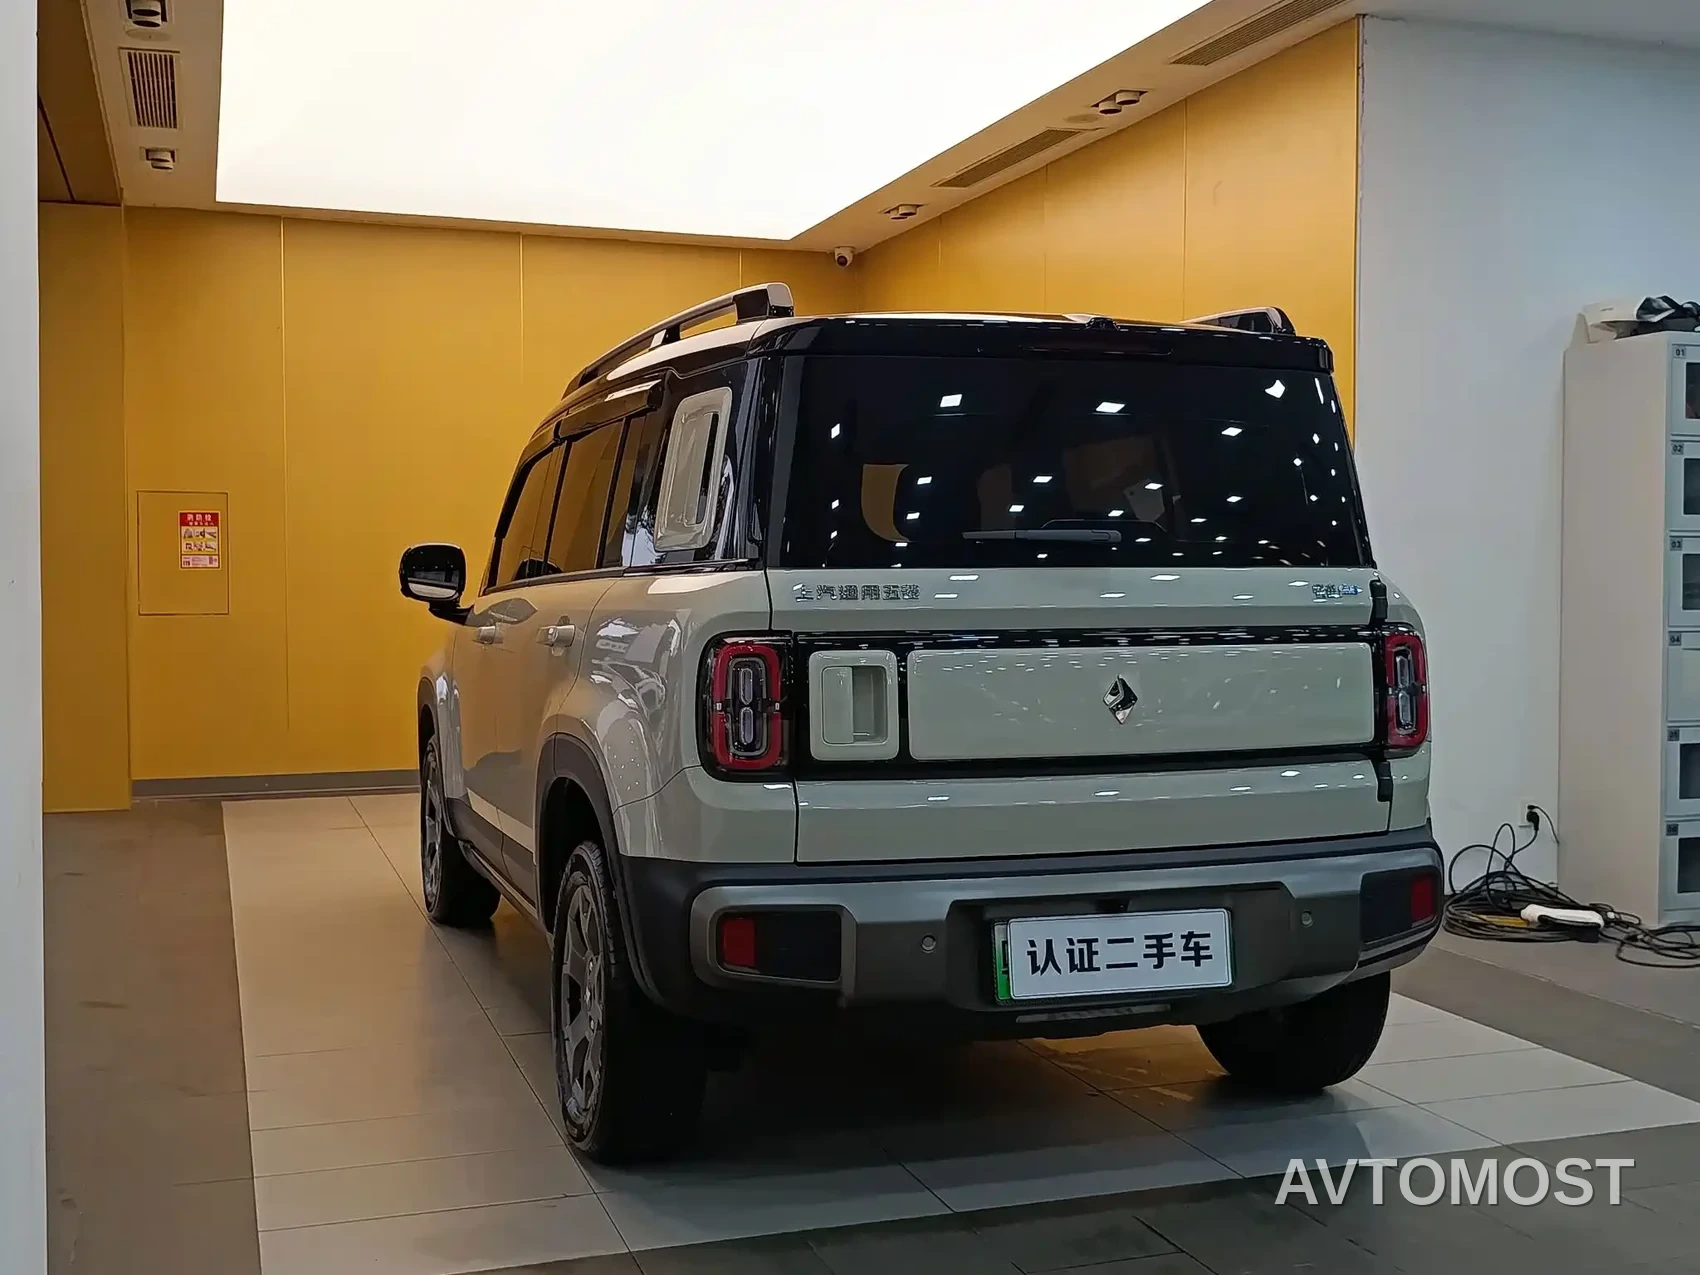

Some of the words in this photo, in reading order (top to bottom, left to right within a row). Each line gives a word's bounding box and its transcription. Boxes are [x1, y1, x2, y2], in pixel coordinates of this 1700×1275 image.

[1675, 348, 1685, 356] 01
[1672, 444, 1683, 453] 02
[1026, 930, 1213, 976] 认证二手车
